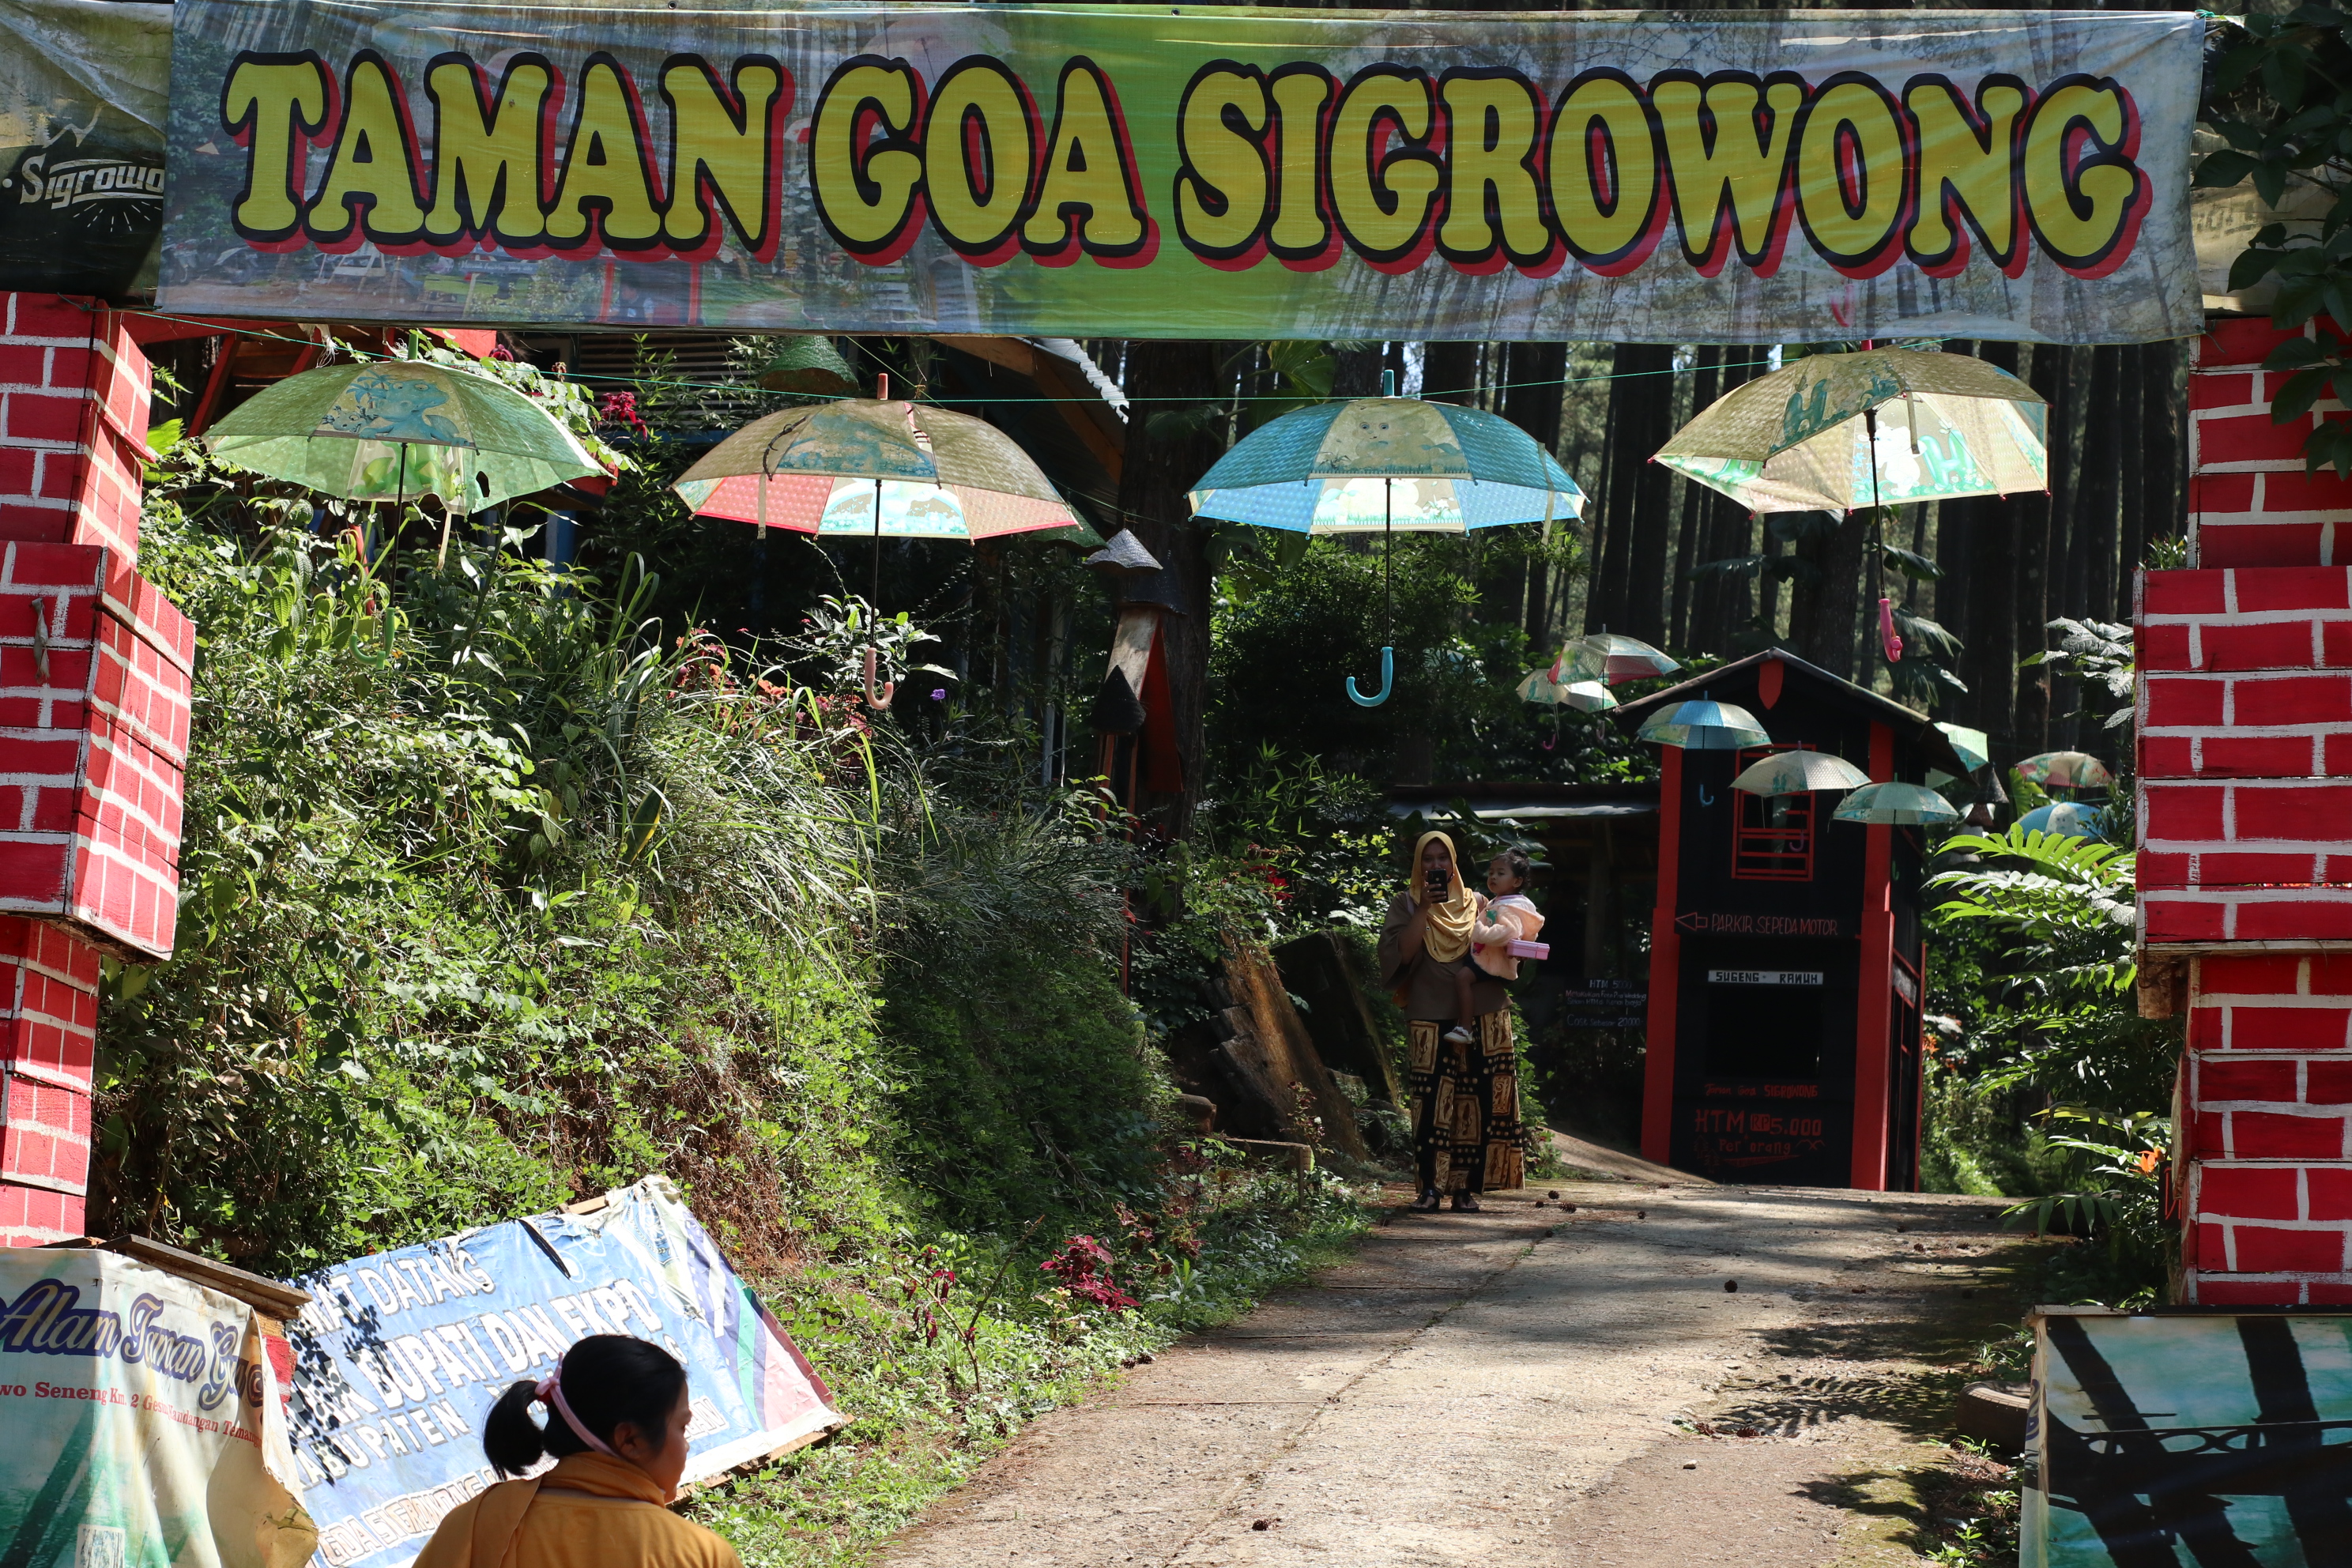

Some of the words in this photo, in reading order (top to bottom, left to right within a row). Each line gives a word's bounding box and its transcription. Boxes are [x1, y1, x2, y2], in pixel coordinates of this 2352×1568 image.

[220, 49, 795, 264] TAMAN
[808, 55, 1160, 269] GOA
[1173, 59, 2153, 280] SIGROWONG
[1712, 914, 1753, 933] PARKIR
[1756, 916, 1798, 934] SEPEDA
[1800, 918, 1838, 936] MOTOR
[1589, 979, 1608, 989] HTM
[1716, 971, 1759, 982] SUGENG
[1764, 1084, 1818, 1099] SIGROWONG
[1694, 1109, 1745, 1134] HTM
[1718, 1138, 1742, 1152] Per
[1749, 1142, 1792, 1155] orang
[356, 1247, 497, 1317] DATANG
[0, 1278, 122, 1359] Alam
[121, 1292, 206, 1384] Taman
[345, 1321, 503, 1412] BUPATI
[477, 1301, 573, 1375] DAN
[35, 1381, 108, 1406] Seneng
[109, 1387, 127, 1406] Km.
[130, 1393, 139, 1408] 2
[168, 1404, 220, 1433] Kandangan
